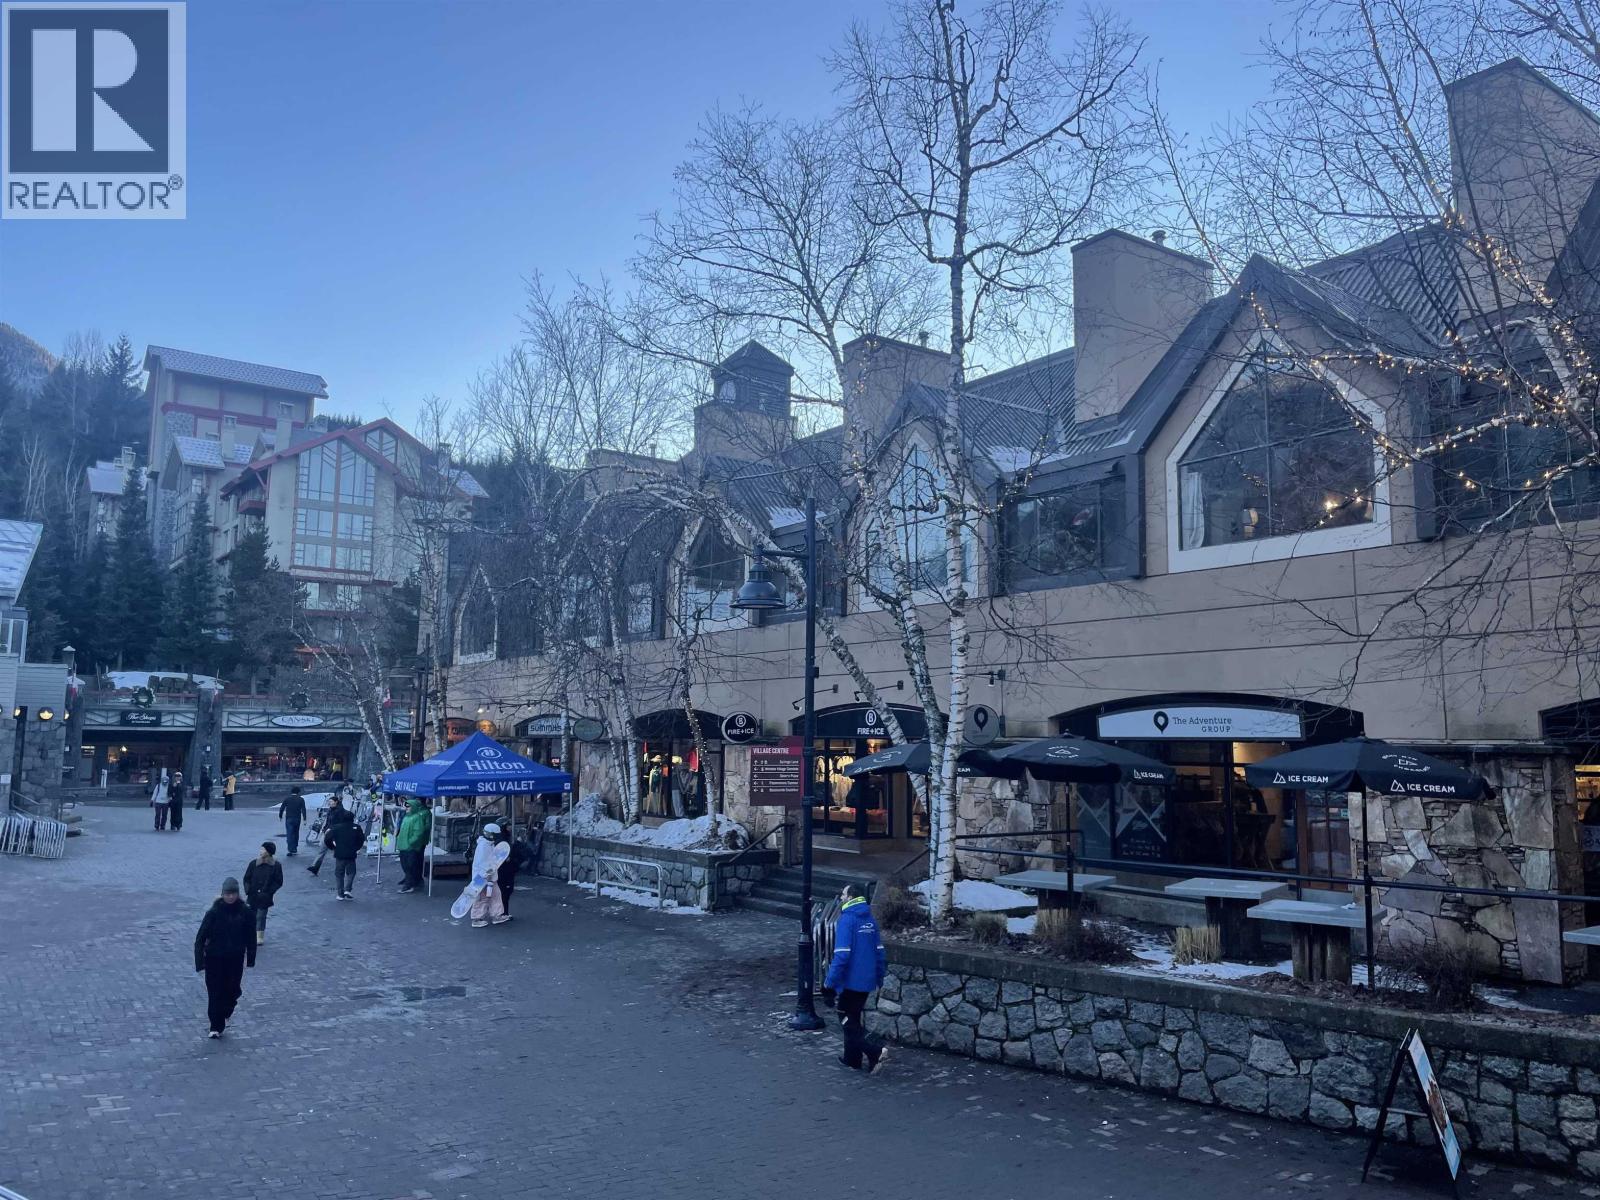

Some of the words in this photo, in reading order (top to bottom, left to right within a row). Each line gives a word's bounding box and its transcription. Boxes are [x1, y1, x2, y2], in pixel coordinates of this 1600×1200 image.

[1171, 717, 1187, 725] The
[1189, 717, 1232, 725] Adventure
[465, 760, 526, 771] Hilton
[477, 781, 496, 792] SKI
[499, 780, 535, 791] VALET
[1406, 783, 1421, 791] ICE
[1423, 784, 1455, 793] CREAM
